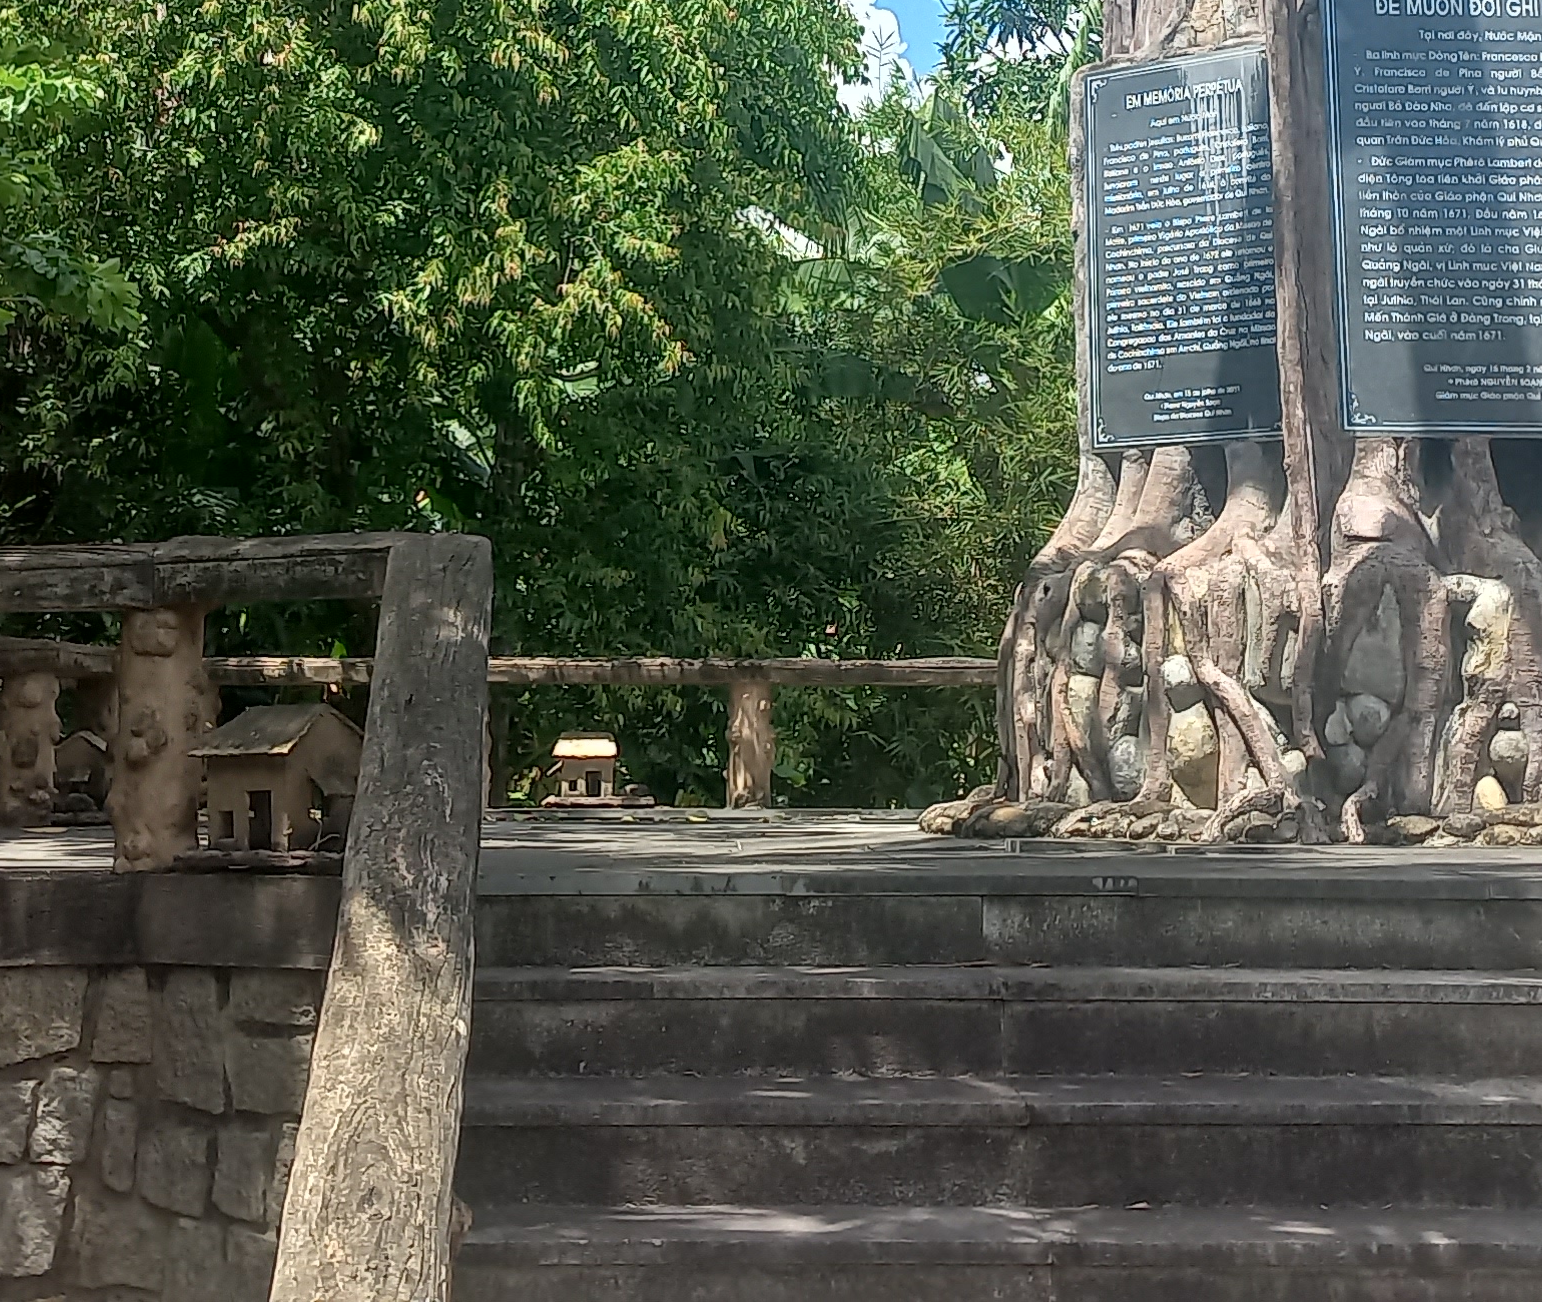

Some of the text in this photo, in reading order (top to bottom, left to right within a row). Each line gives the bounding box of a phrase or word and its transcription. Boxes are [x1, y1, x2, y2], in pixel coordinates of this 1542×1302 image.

[1435, 68, 1449, 77] de
[1127, 94, 1141, 109] EM
[1143, 84, 1190, 106] MEMÓRIA
